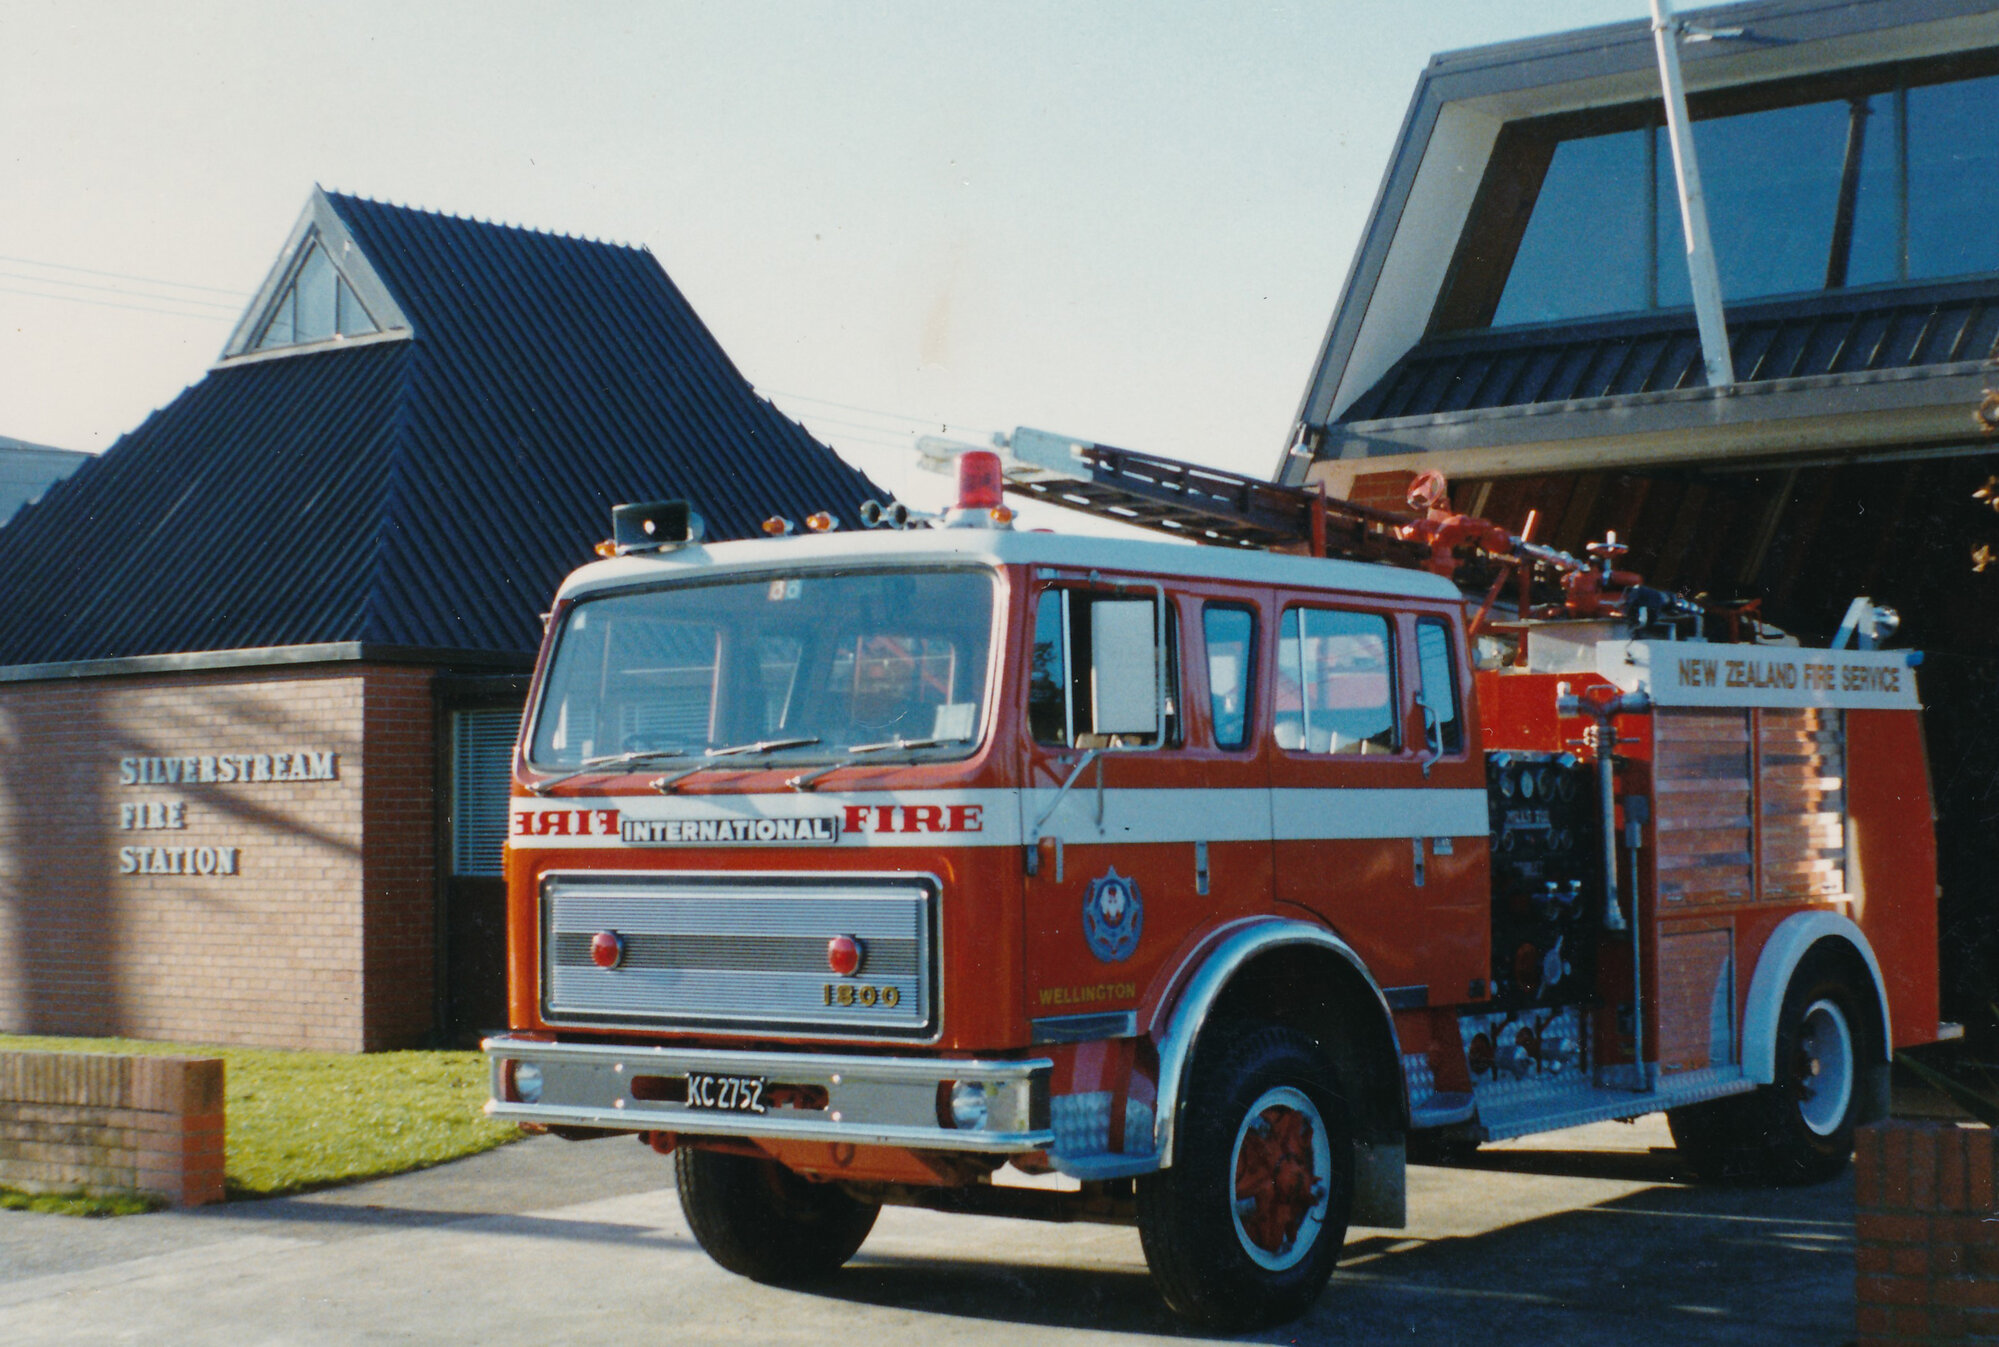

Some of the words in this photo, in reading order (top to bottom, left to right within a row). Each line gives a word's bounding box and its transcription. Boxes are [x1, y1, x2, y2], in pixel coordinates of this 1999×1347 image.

[1678, 658, 1717, 687] NEW
[1725, 659, 1797, 689] ZEALAND
[1803, 662, 1836, 690] FIRE
[1841, 664, 1900, 692] SERVICE
[119, 751, 338, 785] SILVERSTREAM
[119, 801, 185, 830] FIRE
[623, 818, 832, 842] INTERNATIONAL
[841, 804, 984, 834] FIRE
[119, 846, 237, 875] STATION
[823, 983, 900, 1008] 1800
[1039, 983, 1136, 1006] WELLINGTON
